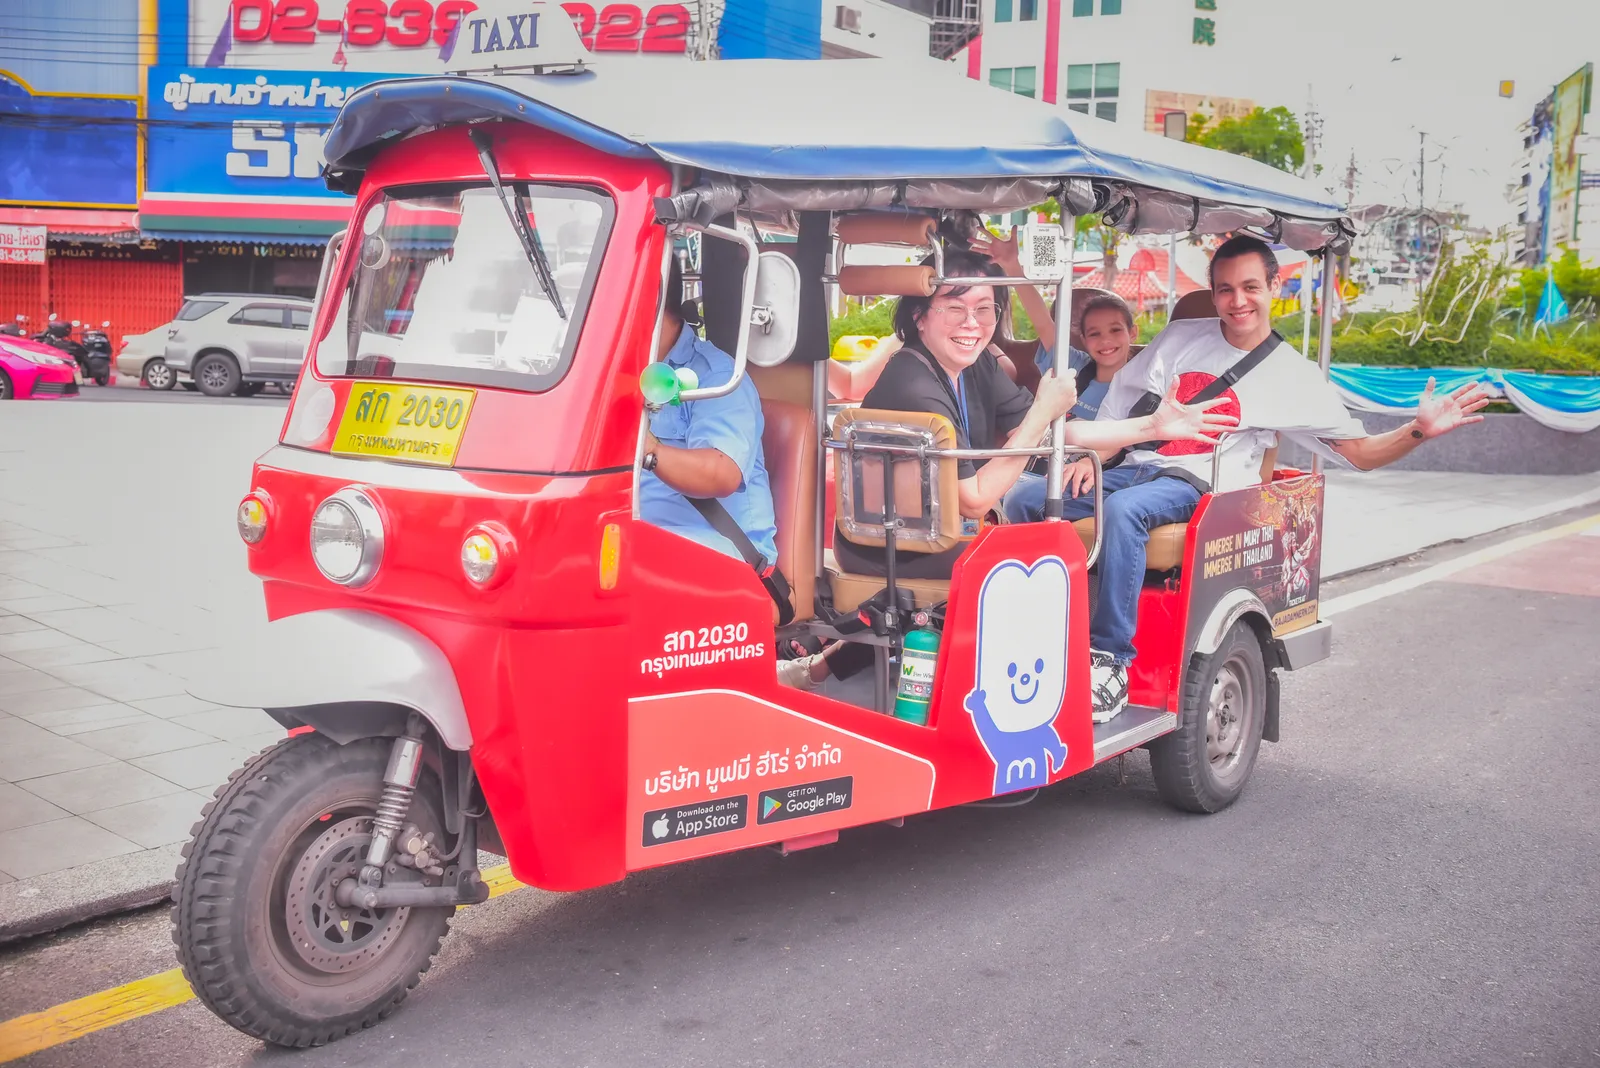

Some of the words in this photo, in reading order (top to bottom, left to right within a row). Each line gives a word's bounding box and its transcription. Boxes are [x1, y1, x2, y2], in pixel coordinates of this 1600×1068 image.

[469, 13, 541, 54] TAXI
[61, 249, 95, 257] HUAT
[355, 389, 391, 424] สก
[397, 393, 464, 430] 2030
[348, 433, 440, 454] กรุงเทพมหานคร
[1204, 535, 1233, 559] IMMERSE
[1235, 532, 1242, 550] IN
[1243, 527, 1261, 548] MUAY
[1262, 524, 1274, 543] THAI
[1203, 555, 1233, 579] IMMERSE
[1234, 552, 1242, 570] IN
[1243, 543, 1273, 567] THAILAND
[663, 630, 695, 653] สก
[697, 622, 748, 648] 2030
[640, 642, 765, 679] กรุงเทพมหานคร
[645, 765, 700, 795] บริษัท
[705, 753, 751, 794] มูฟมี
[755, 747, 790, 777] ฮีโร่
[794, 742, 842, 771] จำกัด
[786, 795, 825, 813] Google
[826, 790, 847, 807] Play
[787, 789, 800, 798] GET
[800, 788, 806, 796] IT
[806, 786, 817, 795] ON
[675, 820, 702, 837] App
[705, 813, 739, 830] Store
[677, 804, 714, 818] Download
[727, 801, 739, 809] the
